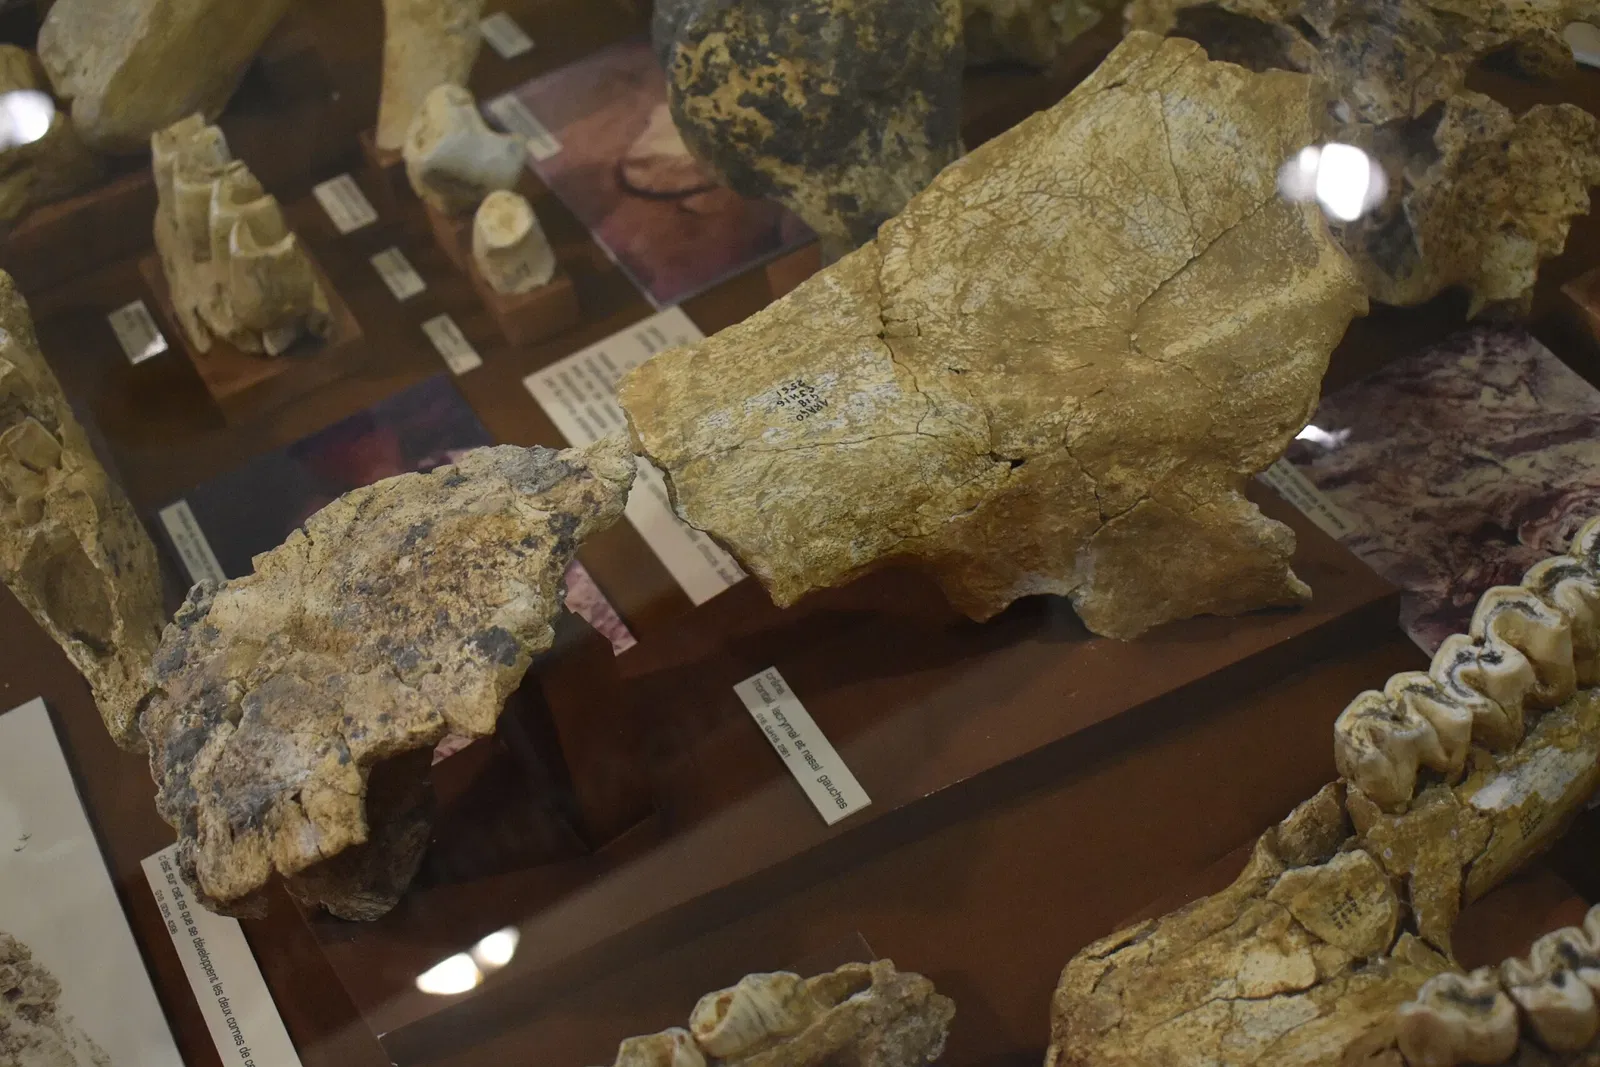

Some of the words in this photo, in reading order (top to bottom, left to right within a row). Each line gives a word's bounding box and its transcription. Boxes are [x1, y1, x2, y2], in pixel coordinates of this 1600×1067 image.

[765, 672, 786, 695] crâne
[771, 705, 800, 740] lacrymal
[794, 739, 806, 751] et
[801, 749, 824, 772] nasal
[817, 774, 848, 810] gauches
[165, 870, 178, 886] sur
[171, 886, 183, 901] cet
[177, 899, 187, 909] os
[179, 910, 194, 927] que
[188, 926, 199, 937] se
[192, 935, 219, 983] développent
[211, 981, 224, 996] les
[217, 996, 233, 1017] deux
[225, 1017, 245, 1046] cornes
[238, 1043, 251, 1059] de
